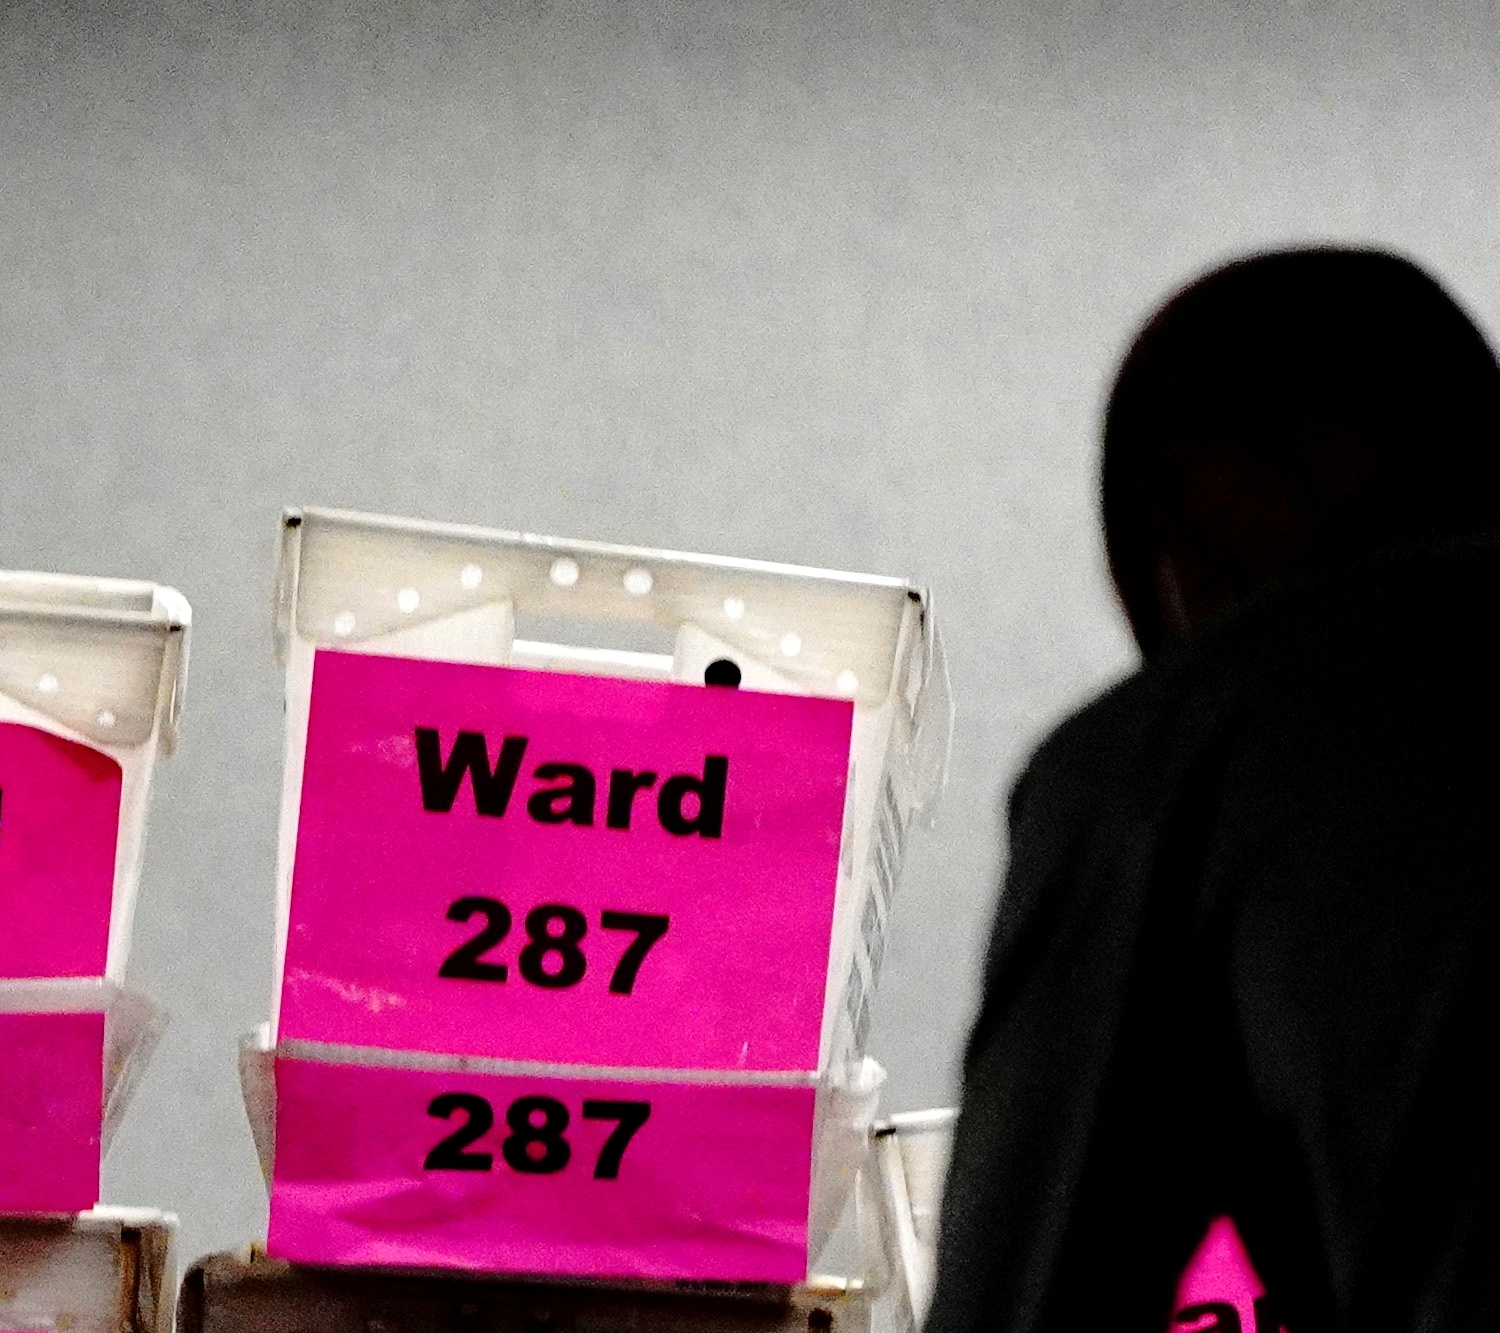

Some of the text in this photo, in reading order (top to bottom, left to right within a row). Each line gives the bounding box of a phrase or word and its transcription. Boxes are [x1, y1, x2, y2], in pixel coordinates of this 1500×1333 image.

[415, 728, 728, 838] Ward
[439, 896, 669, 994] 287
[424, 1093, 651, 1180] 287
